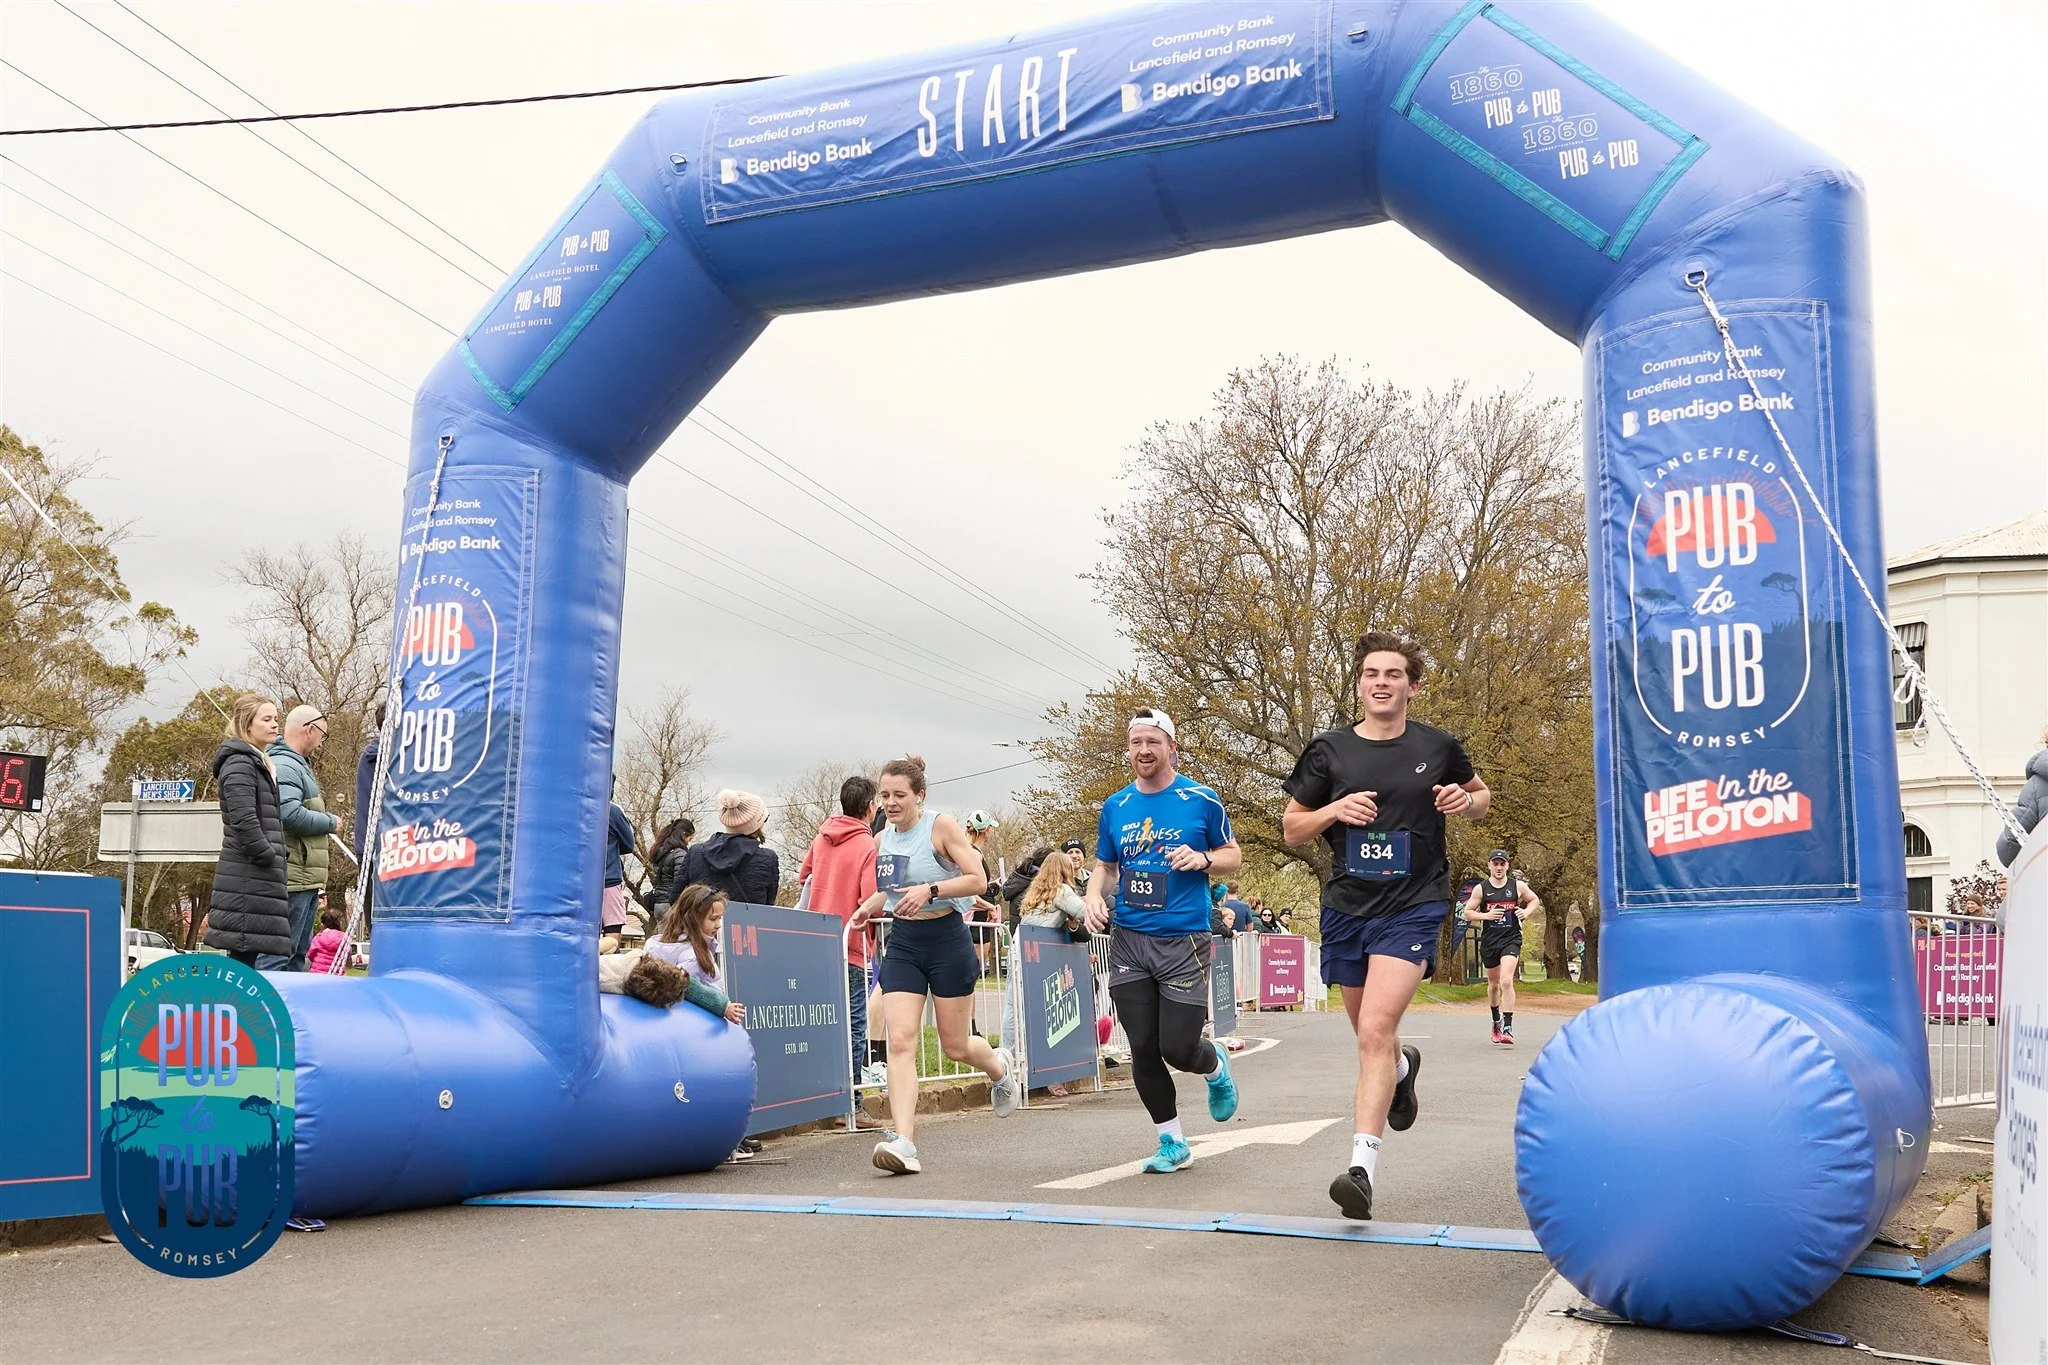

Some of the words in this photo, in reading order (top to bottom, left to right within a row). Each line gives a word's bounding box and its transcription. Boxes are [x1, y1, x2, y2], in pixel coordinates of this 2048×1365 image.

[1152, 24, 1234, 48] Community
[1237, 14, 1274, 32] Bank
[1129, 48, 1201, 72] Lancefield
[1204, 42, 1233, 57] and
[1236, 32, 1296, 52] Romsey
[1152, 72, 1240, 102] Bendigo
[1245, 58, 1302, 86] Bank
[1450, 68, 1522, 100] 1860
[748, 106, 817, 126] Community
[819, 98, 852, 113] Bank
[916, 47, 1078, 158] START
[1484, 96, 1513, 128] PUB
[1516, 100, 1529, 114] to
[1532, 88, 1562, 118] PUB
[728, 126, 788, 148] Lancefield
[791, 122, 816, 136] and
[817, 114, 868, 132] Romsey
[1522, 118, 1598, 150] 1860
[746, 150, 821, 176] Bendigo
[825, 137, 873, 162] Bank
[1558, 147, 1588, 180] PUB
[1592, 150, 1605, 165] to
[1608, 139, 1639, 169] PUB
[560, 234, 580, 258] PUB
[590, 229, 610, 253] PUB
[530, 266, 572, 280] LANCEFIELD
[574, 264, 600, 272] HOTEL
[514, 290, 532, 312] PUB
[542, 285, 562, 308] PUB
[486, 320, 526, 334] LANCEFIELD
[528, 318, 553, 327] HOTEL
[1642, 350, 1721, 375] Community
[1626, 374, 1692, 401] Lancefield
[1694, 370, 1723, 384] and
[1726, 367, 1786, 384] Romsey
[1647, 398, 1734, 427] Bendigo
[1738, 392, 1795, 412] Bank
[1644, 446, 1776, 489] LANCEFIELD
[412, 501, 453, 517] Comunity
[455, 498, 482, 509] Bank
[436, 516, 453, 526] and
[454, 516, 498, 527] Romsey
[1664, 482, 1758, 574] PUB
[410, 538, 457, 556] Bendigo
[460, 536, 501, 550] Bank
[1692, 574, 1737, 615] to
[406, 602, 464, 669] PUB
[1671, 622, 1766, 713] PUB
[416, 671, 442, 702] to
[398, 707, 456, 775] PUB
[1676, 726, 1767, 748] ROMSEY
[144, 782, 180, 790] LANCEFIELD
[164, 790, 180, 798] SHED
[396, 786, 450, 802] ROMSEY
[1644, 780, 1708, 821] LIFE
[1747, 768, 1793, 795] the
[380, 825, 410, 852] LIFE
[433, 818, 464, 836] the
[1120, 827, 1183, 845] WELLNESS
[1646, 792, 1800, 849] PELOTON
[378, 837, 467, 876] PELOTON
[1360, 842, 1394, 860] 834
[877, 864, 894, 878] 739
[1130, 880, 1153, 894] 833
[744, 1004, 806, 1030] LANCEFIELD
[808, 1004, 838, 1026] HOTEL
